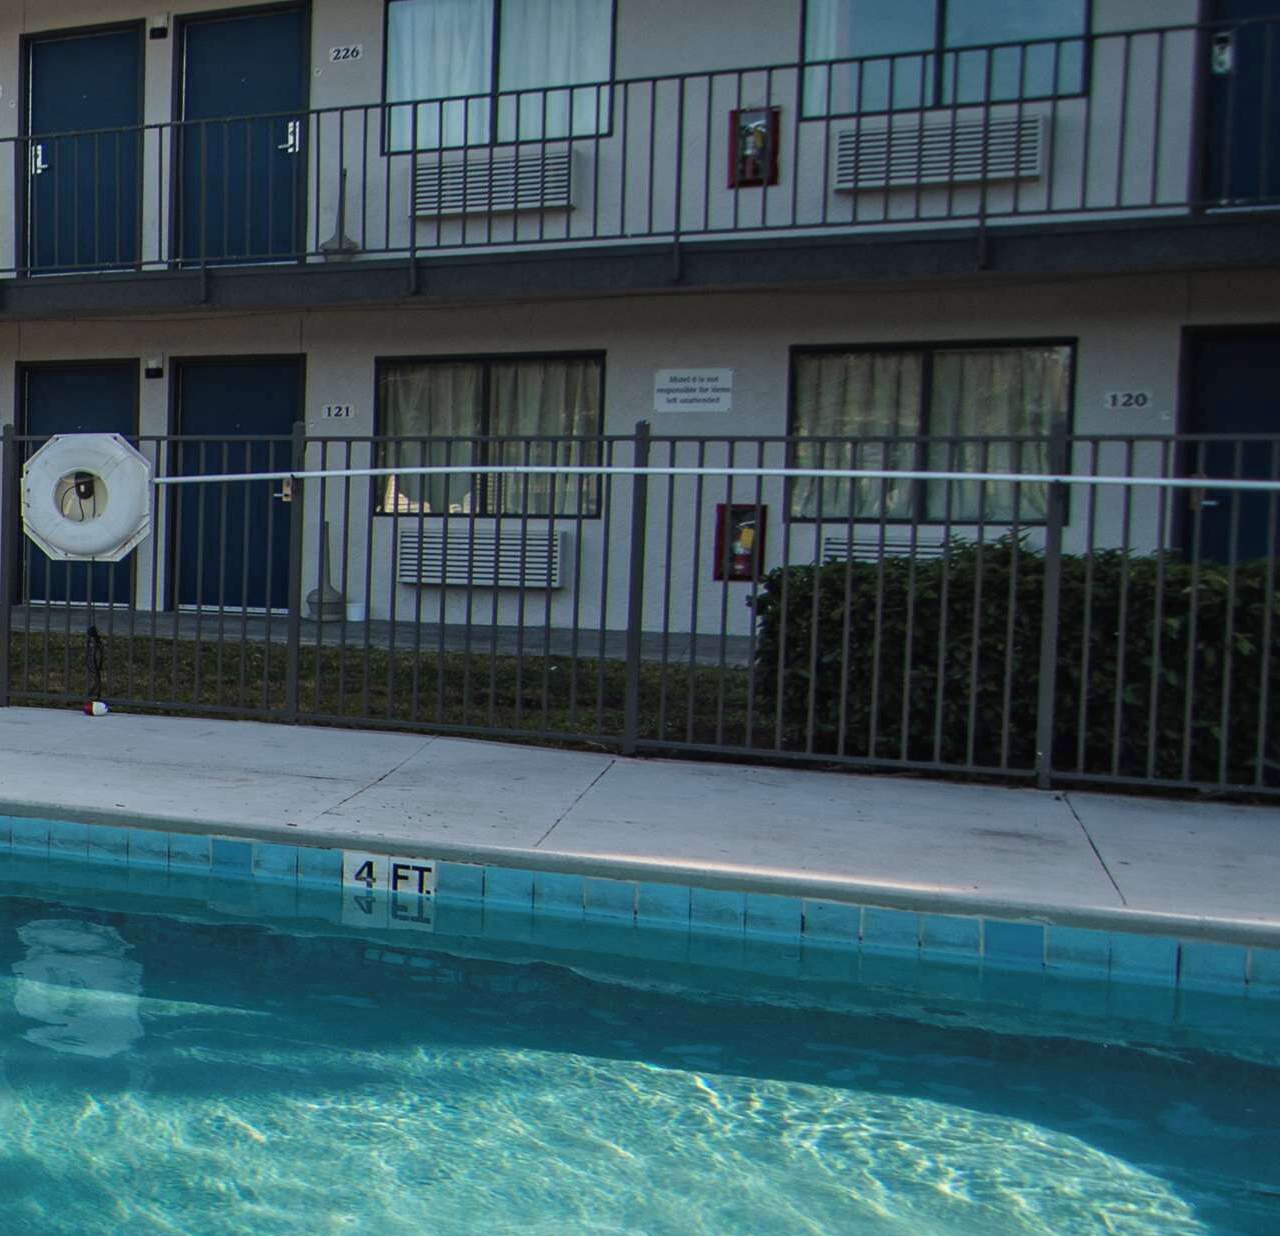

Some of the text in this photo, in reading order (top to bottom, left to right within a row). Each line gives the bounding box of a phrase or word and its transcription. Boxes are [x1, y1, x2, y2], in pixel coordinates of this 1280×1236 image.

[332, 46, 359, 60] 226
[1110, 393, 1148, 407] 120
[326, 406, 350, 417] 121
[354, 860, 432, 894] 4 FT.
